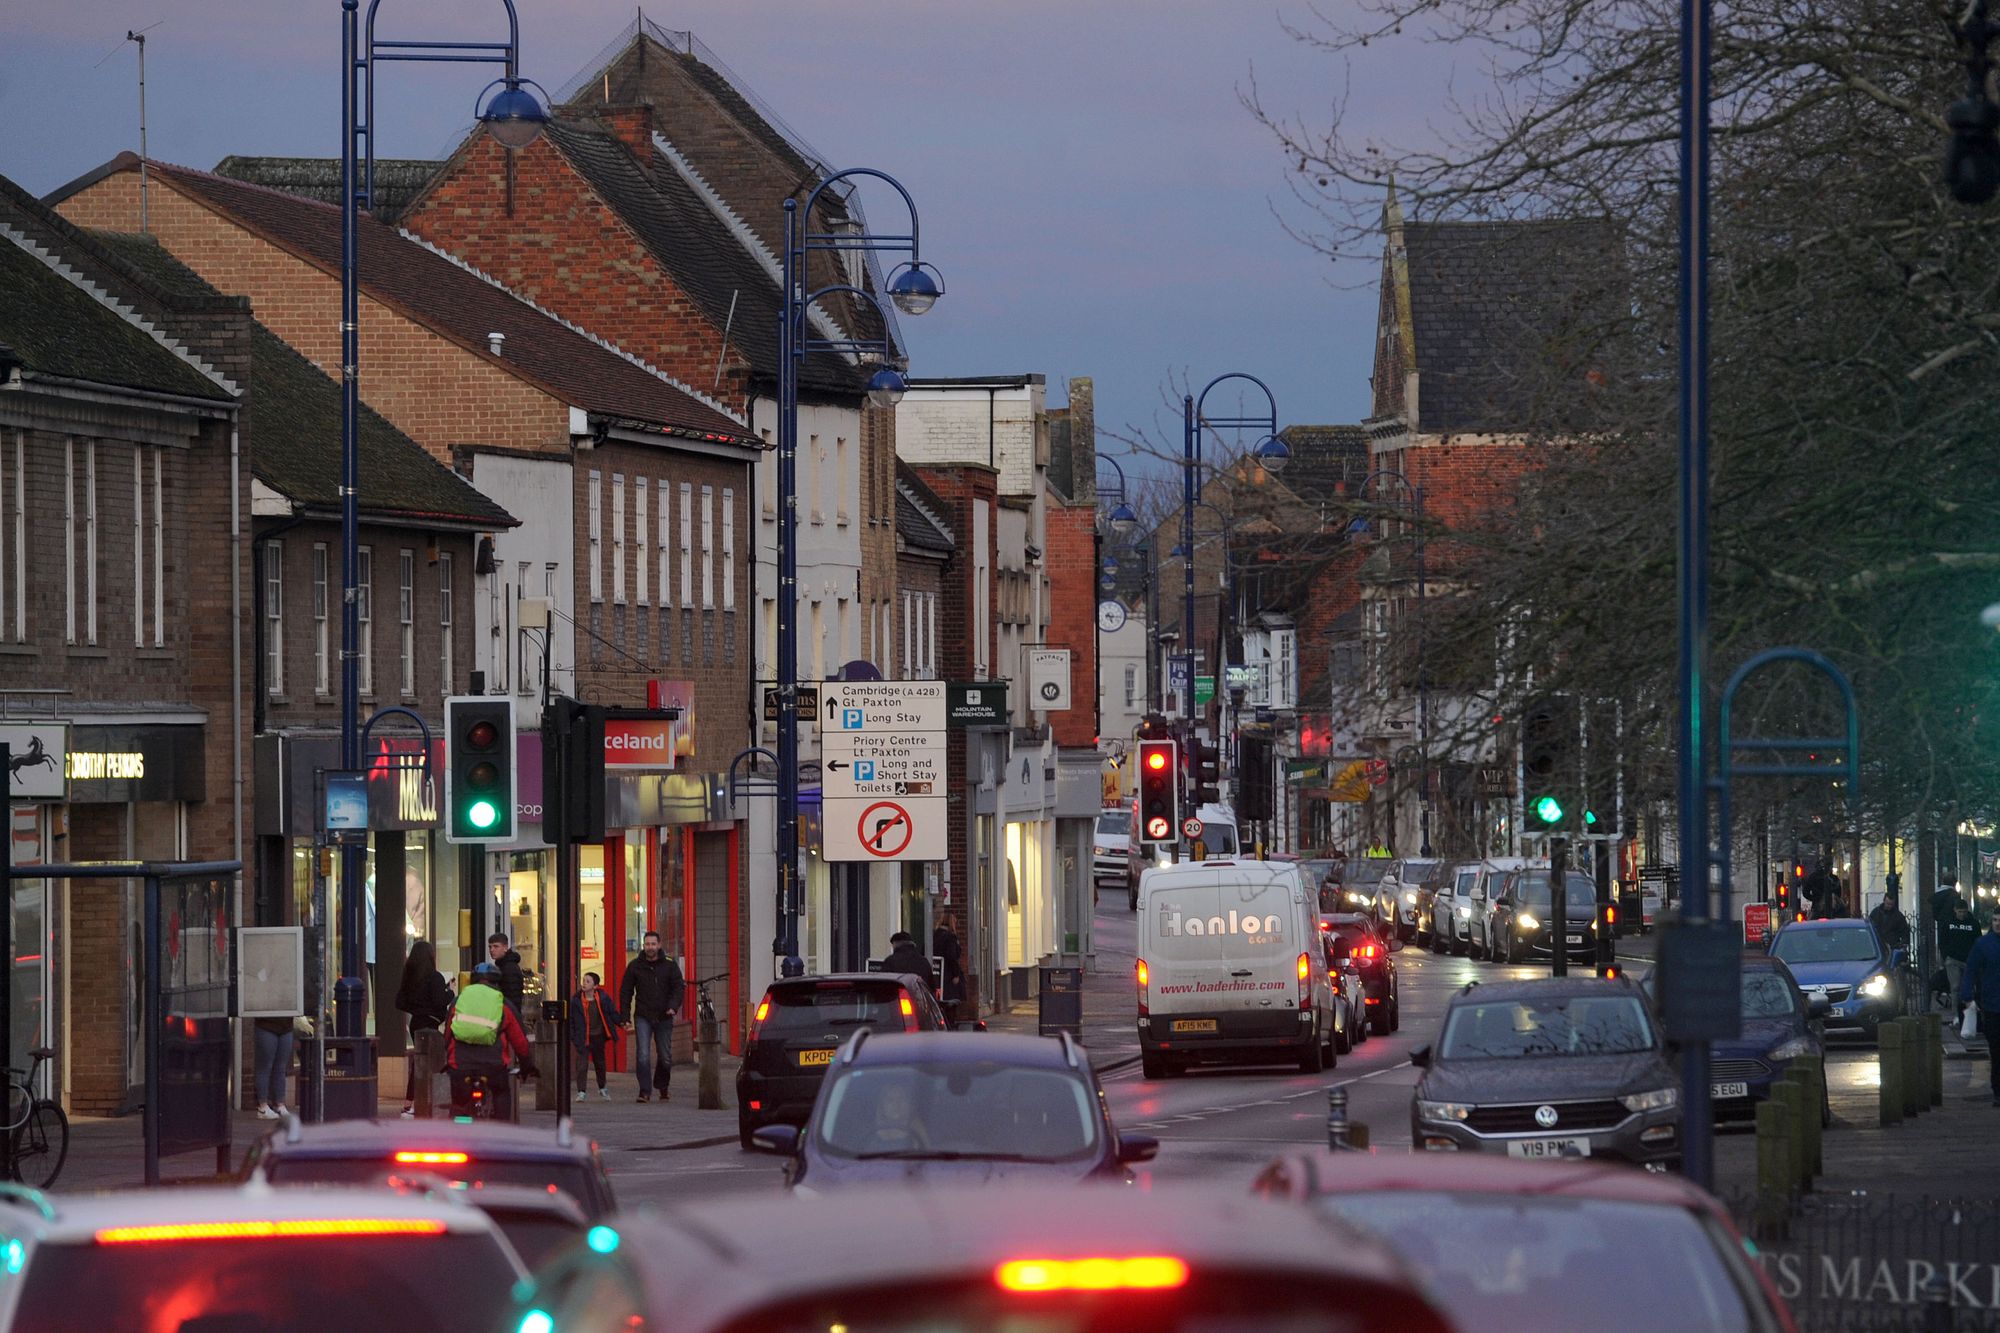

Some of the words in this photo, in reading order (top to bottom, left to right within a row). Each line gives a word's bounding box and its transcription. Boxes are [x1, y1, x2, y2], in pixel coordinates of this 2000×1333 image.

[842, 686, 900, 697] Cambridge
[767, 693, 816, 706] Ams
[863, 698, 901, 707] Paxton
[847, 710, 860, 728] P
[865, 713, 891, 724] Long
[897, 713, 921, 724] Stay
[604, 733, 665, 749] celand
[853, 736, 885, 747] Priory
[890, 736, 927, 745] Centre
[871, 748, 910, 757] Paxton
[858, 762, 872, 780] P
[881, 760, 908, 769] Long
[912, 759, 932, 769] and
[877, 770, 908, 780] Short
[912, 770, 937, 781] Stay
[1482, 769, 1504, 784] VIP
[854, 783, 892, 793] Toilets
[1186, 823, 1200, 832] 20
[1159, 909, 1283, 938] Hanlon
[1949, 923, 1973, 932] PARIS
[1160, 980, 1286, 995] www.loaderhire.com
[1721, 1083, 1744, 1096] EGU
[1521, 1141, 1545, 1156] V19
